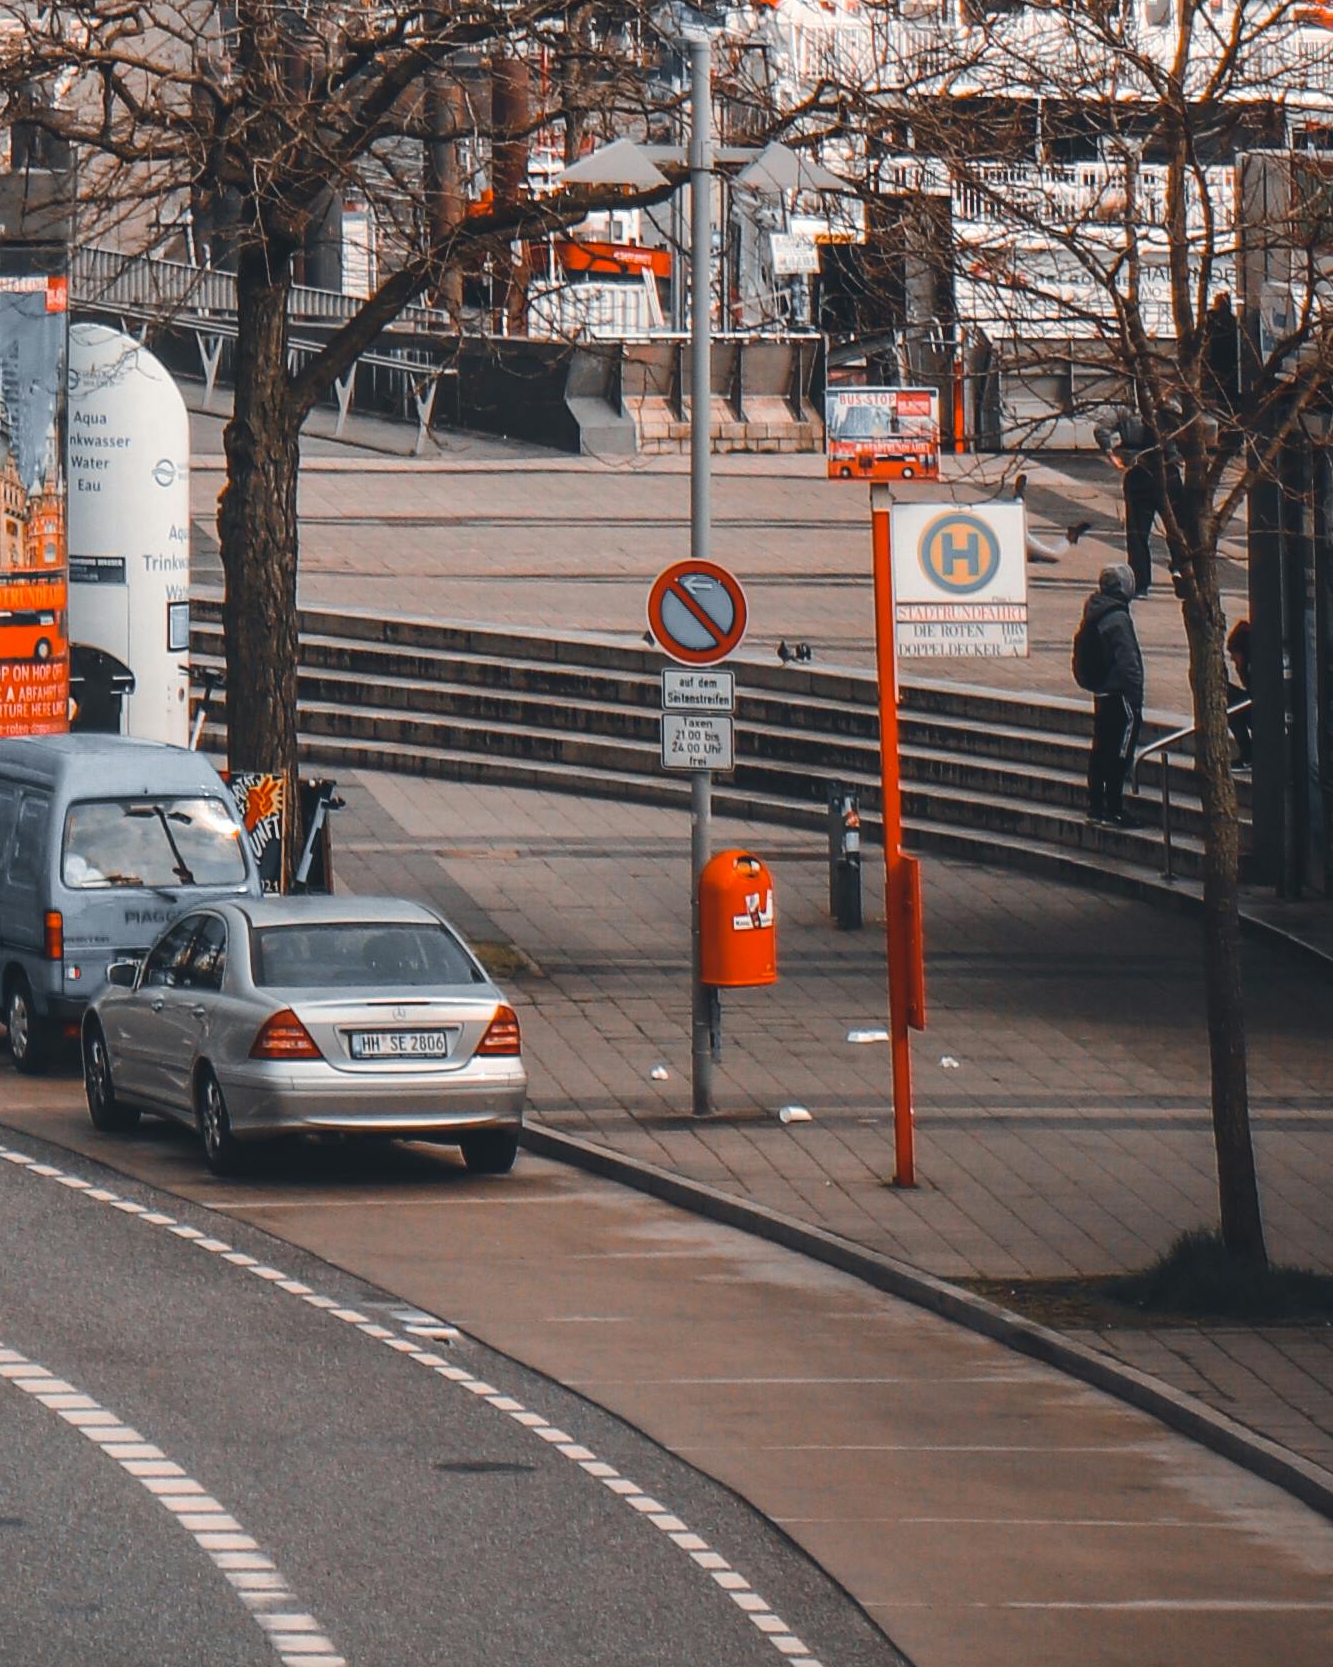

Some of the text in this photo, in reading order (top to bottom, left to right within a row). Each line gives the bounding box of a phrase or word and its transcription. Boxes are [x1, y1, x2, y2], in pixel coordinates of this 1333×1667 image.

[839, 394, 896, 406] BUS STOP
[73, 410, 107, 426] Aqua
[69, 435, 132, 448] nkwasser
[71, 455, 110, 470] Water
[78, 478, 101, 492] Eau
[941, 532, 979, 576] H
[899, 606, 1024, 621] STADTRUNDFAHRT
[914, 624, 985, 638] DIE ROTEN
[899, 643, 1002, 657] DOPPELDECKER
[13, 665, 30, 682] ON
[33, 663, 51, 681] HOP
[679, 676, 718, 689] auf dem
[6, 686, 16, 703] A
[667, 691, 730, 706] Seitenstreifen
[683, 717, 713, 729] Taxen
[704, 731, 720, 742] bis
[704, 742, 722, 754] Uhr
[689, 756, 707, 766] frei
[124, 909, 184, 925] PIAGG
[361, 1034, 444, 1052] HH SE 2806
